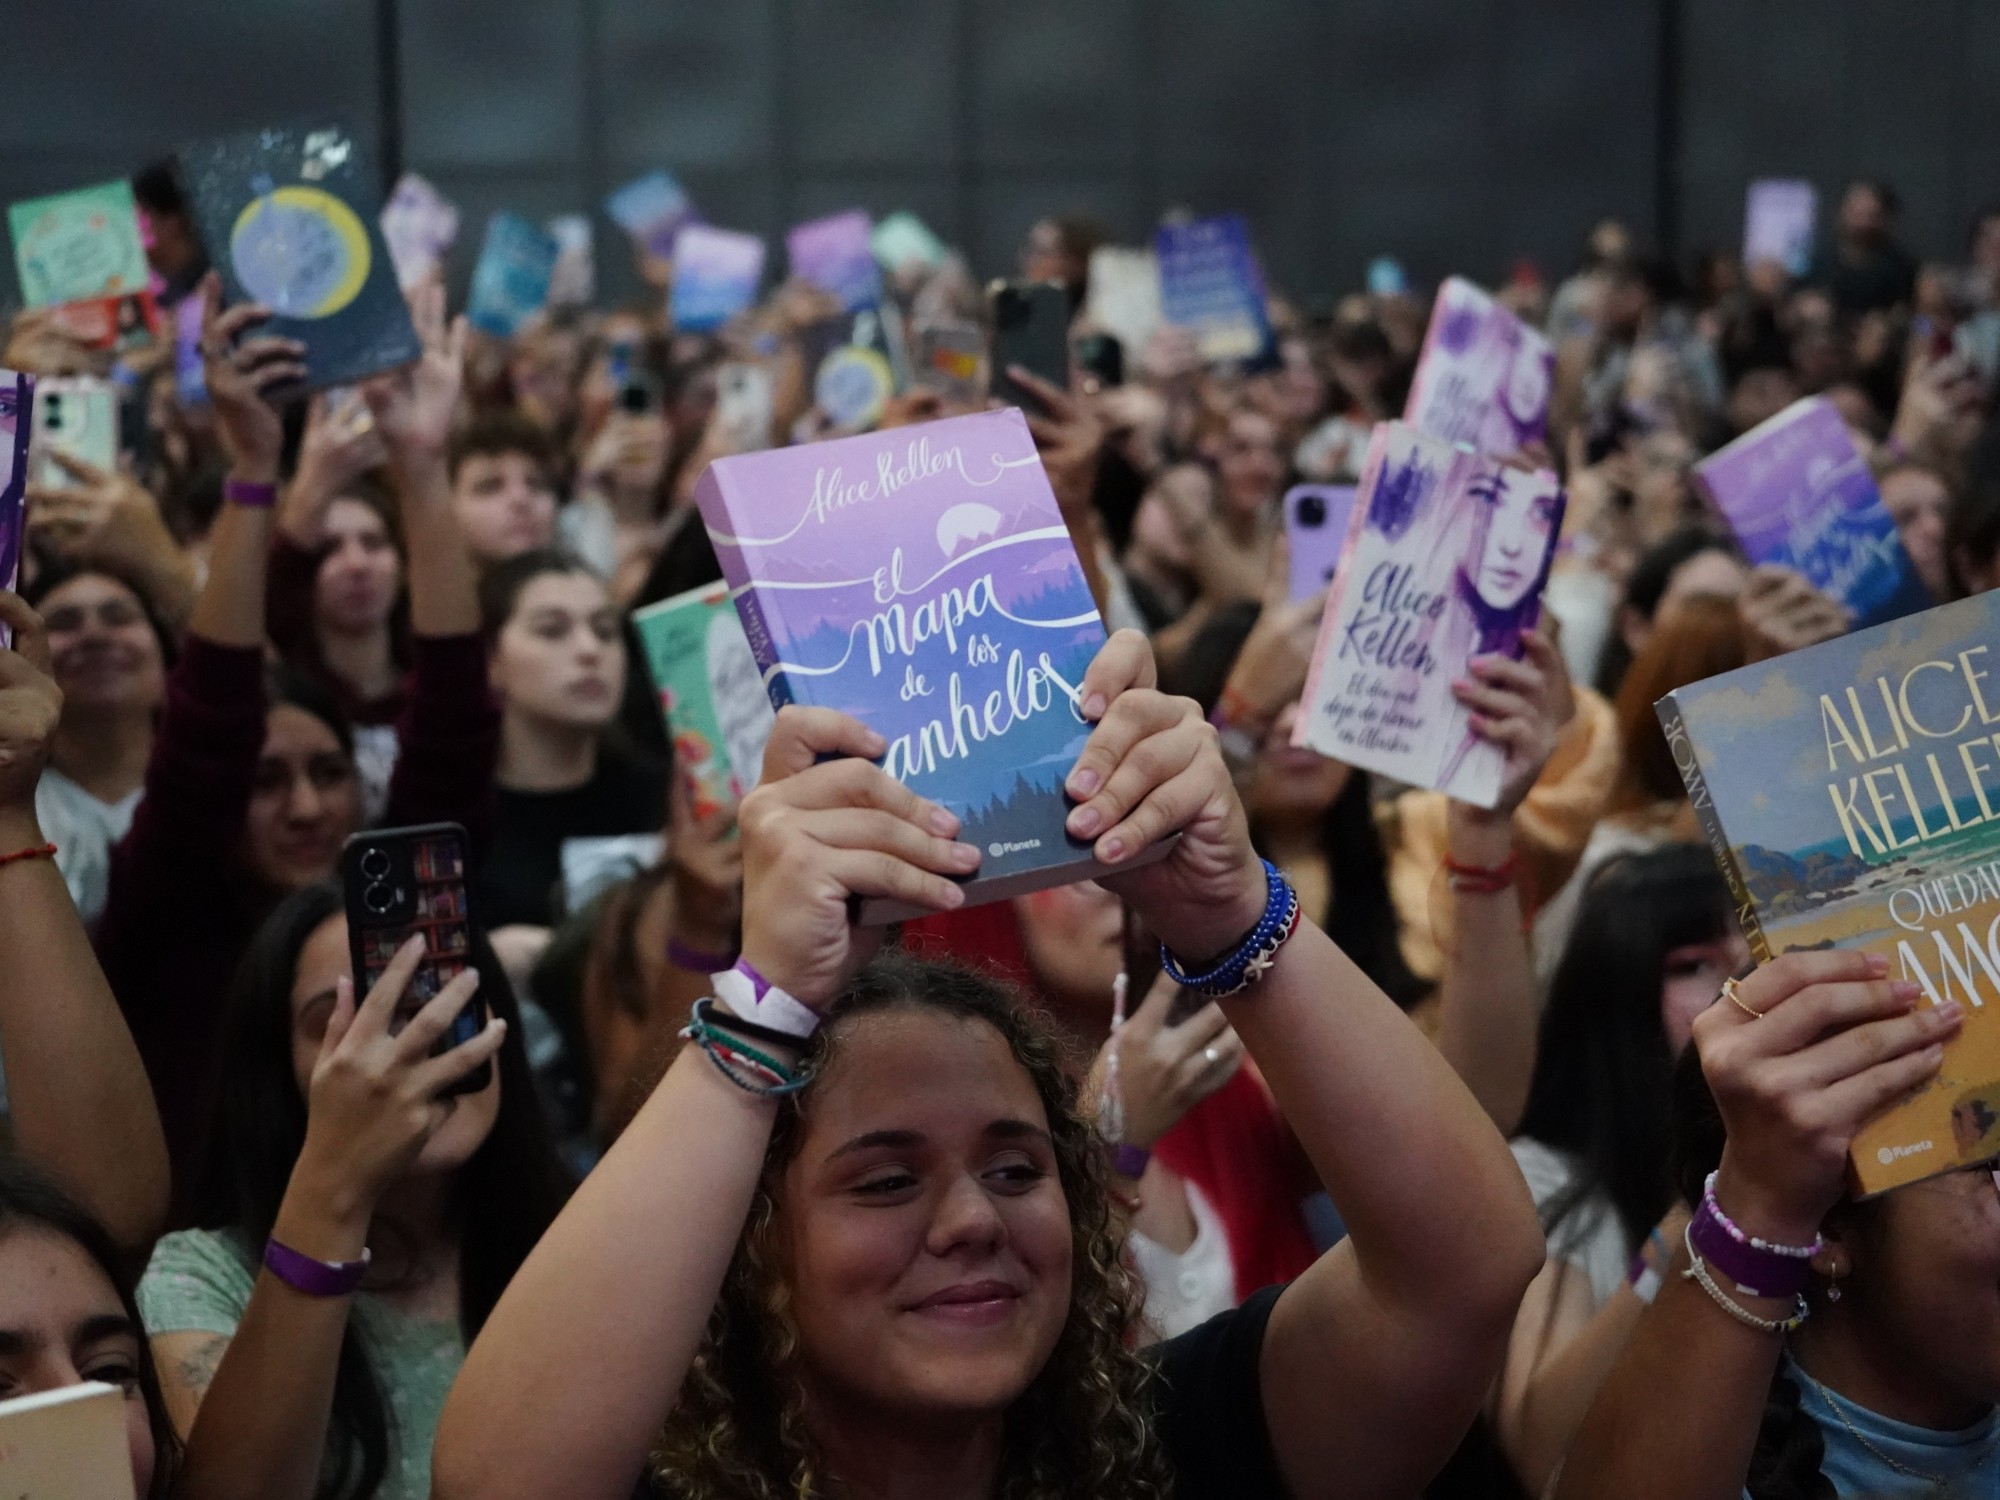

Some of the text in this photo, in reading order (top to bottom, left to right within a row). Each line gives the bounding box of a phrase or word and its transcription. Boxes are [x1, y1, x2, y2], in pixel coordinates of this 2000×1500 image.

[804, 436, 968, 524] Alice Kellen
[872, 547, 904, 604] El
[900, 633, 1002, 702] de los
[1338, 606, 1437, 677] Kellen
[882, 649, 1090, 786] anhelos
[1820, 645, 2000, 772] ALICE
[1664, 715, 1712, 810] AMOR
[1828, 732, 2000, 860] KELLE
[1003, 838, 1042, 853] Planeta
[1897, 912, 2000, 1007] AM
[1892, 1140, 1933, 1159] Planeta
